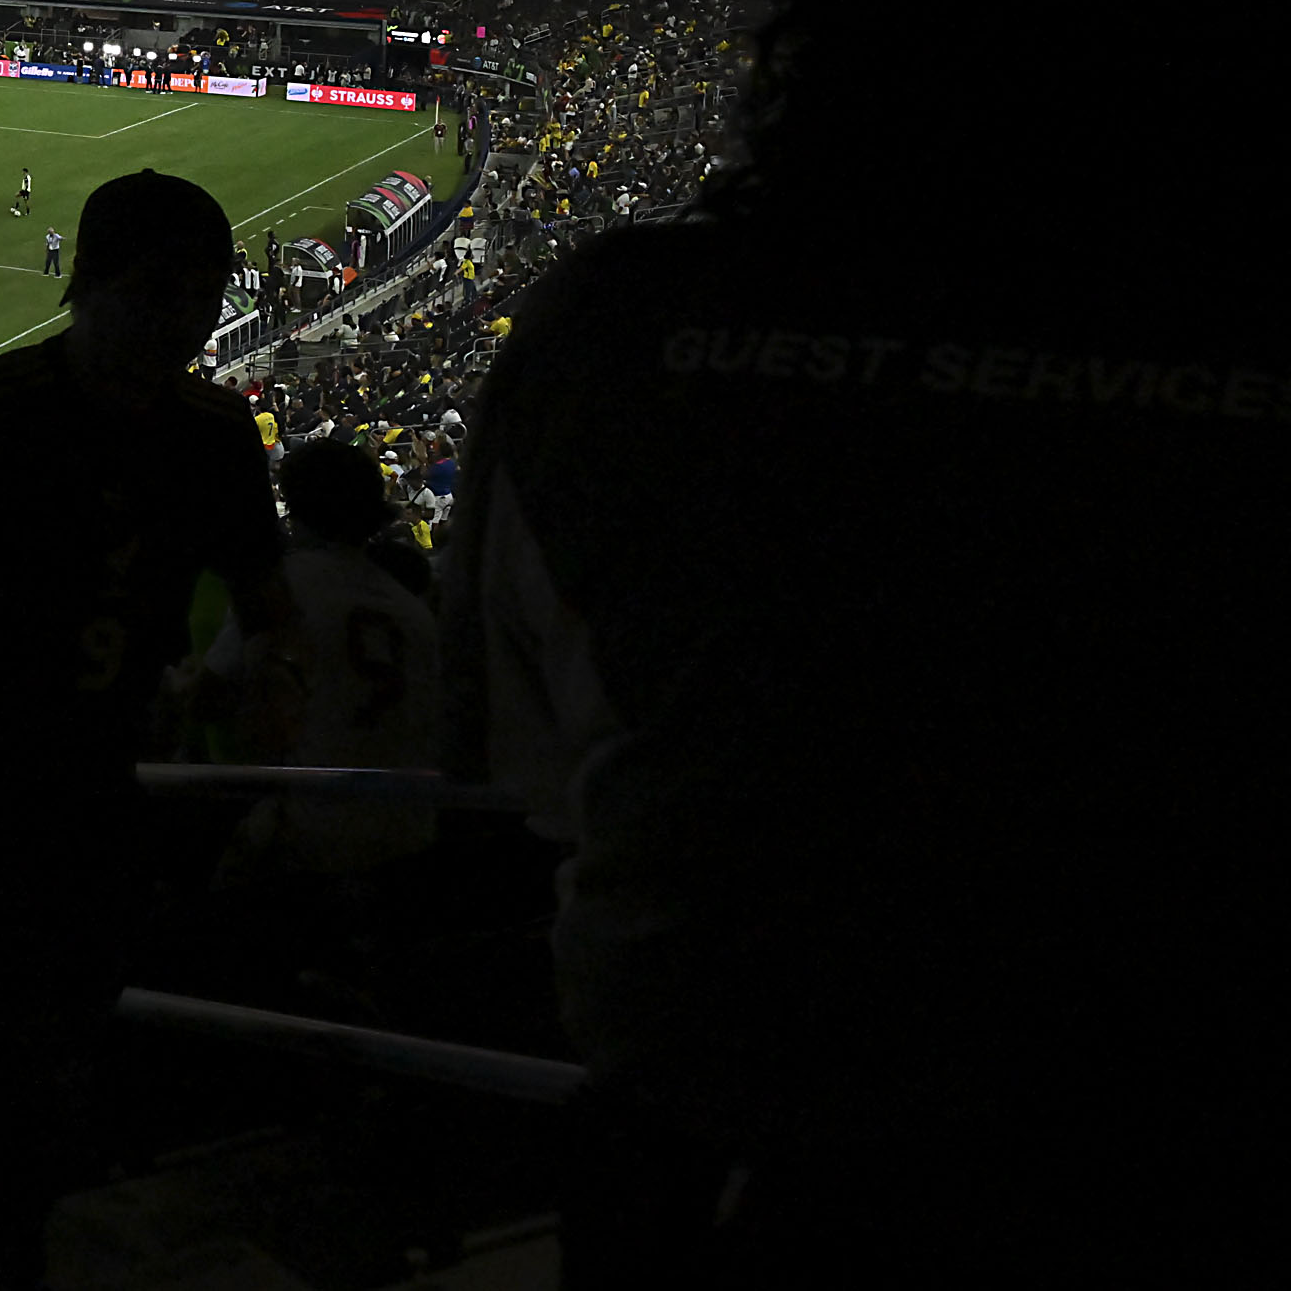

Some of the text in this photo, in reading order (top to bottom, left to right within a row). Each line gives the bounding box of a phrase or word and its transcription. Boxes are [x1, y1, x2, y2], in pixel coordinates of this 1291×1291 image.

[328, 90, 394, 106] STRAUSS
[659, 326, 907, 384] GUEST
[75, 614, 131, 694] 9
[347, 607, 406, 731] 9
